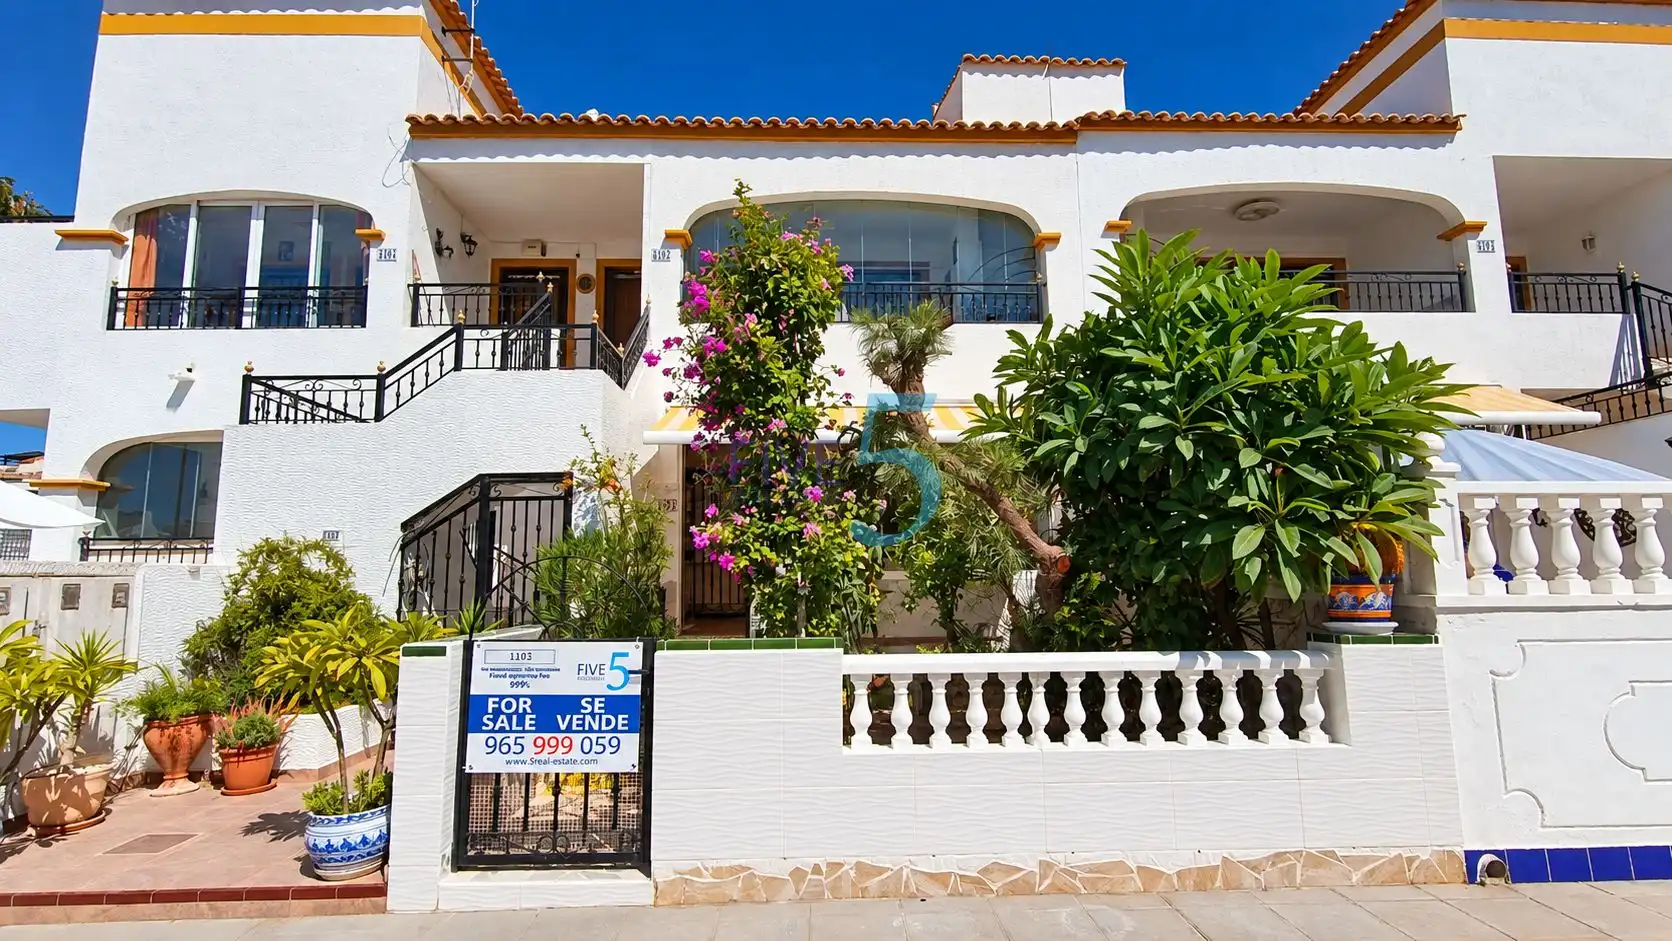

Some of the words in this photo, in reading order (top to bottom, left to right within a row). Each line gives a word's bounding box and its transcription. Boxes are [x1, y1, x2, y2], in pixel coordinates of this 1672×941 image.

[510, 652, 532, 661] 1103
[577, 663, 606, 676] FIVE
[606, 652, 630, 691] 5
[487, 697, 532, 714] FOR
[580, 697, 606, 714] SE
[481, 714, 536, 731] SALE
[556, 714, 629, 731] VENDE
[485, 736, 525, 755] 965
[533, 736, 573, 755] 999
[580, 736, 621, 755] 059
